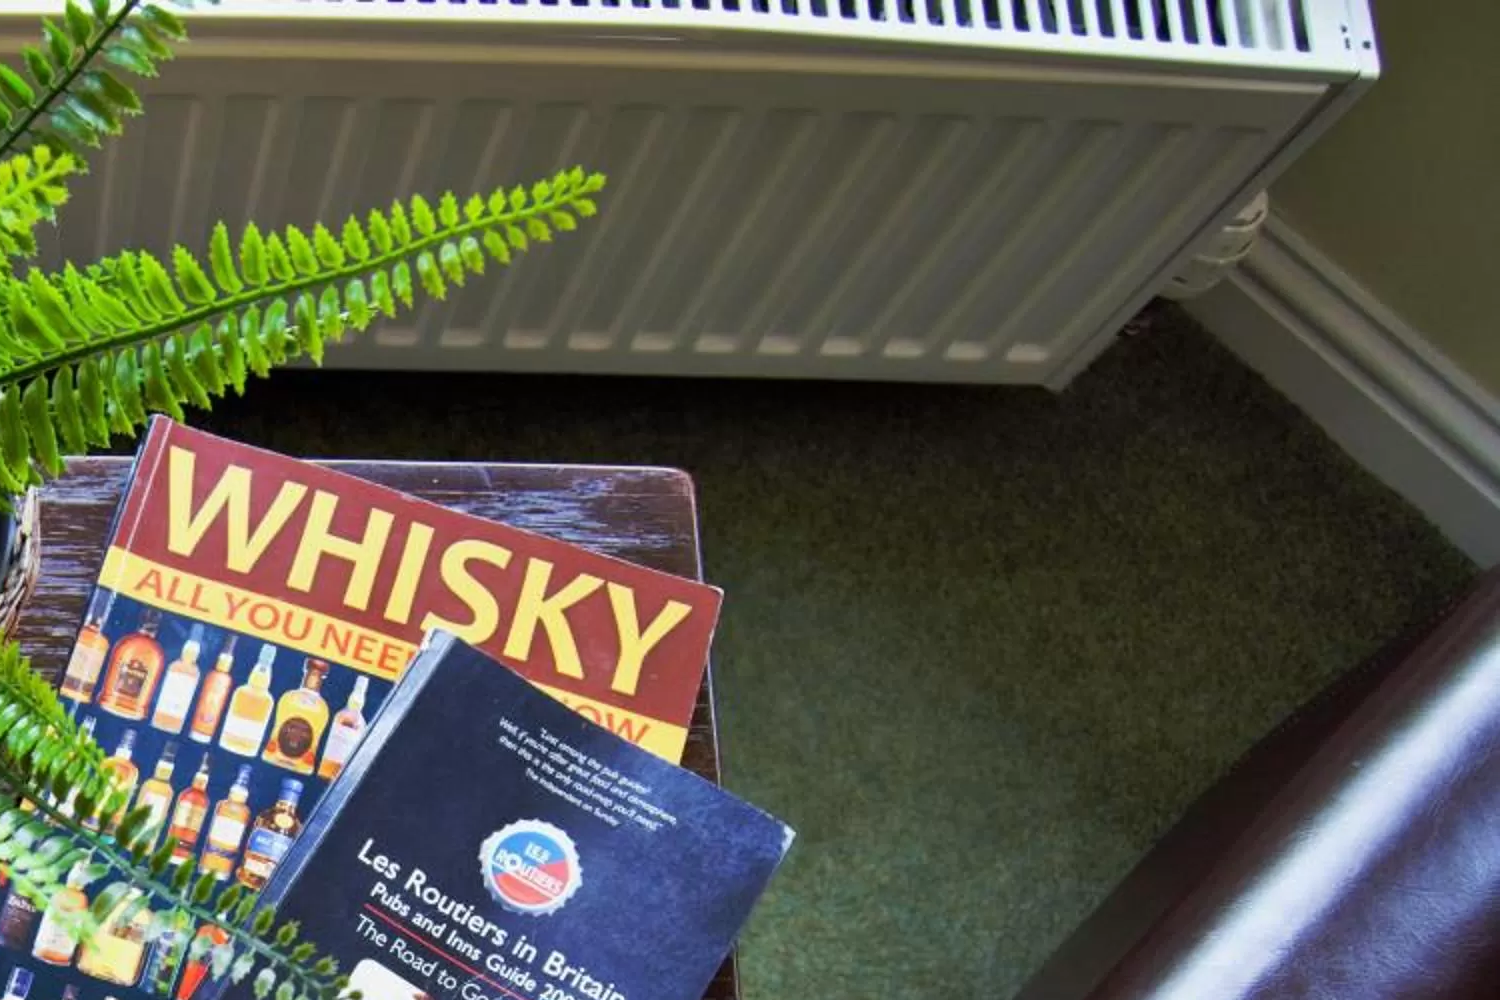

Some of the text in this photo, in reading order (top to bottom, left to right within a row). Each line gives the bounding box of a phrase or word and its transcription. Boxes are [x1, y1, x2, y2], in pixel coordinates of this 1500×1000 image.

[135, 568, 210, 615] ALL
[224, 595, 311, 643] YOU
[321, 623, 416, 673] NEE
[168, 446, 692, 696] WHISKY
[356, 913, 387, 947] The
[389, 937, 438, 977] Road
[437, 969, 457, 990] to
[357, 838, 400, 880] Les
[404, 868, 508, 946] Routiers
[512, 935, 537, 963] in
[370, 881, 410, 917] Pubs
[411, 912, 447, 938] and
[446, 930, 482, 961] Inns
[486, 954, 537, 992] Guide
